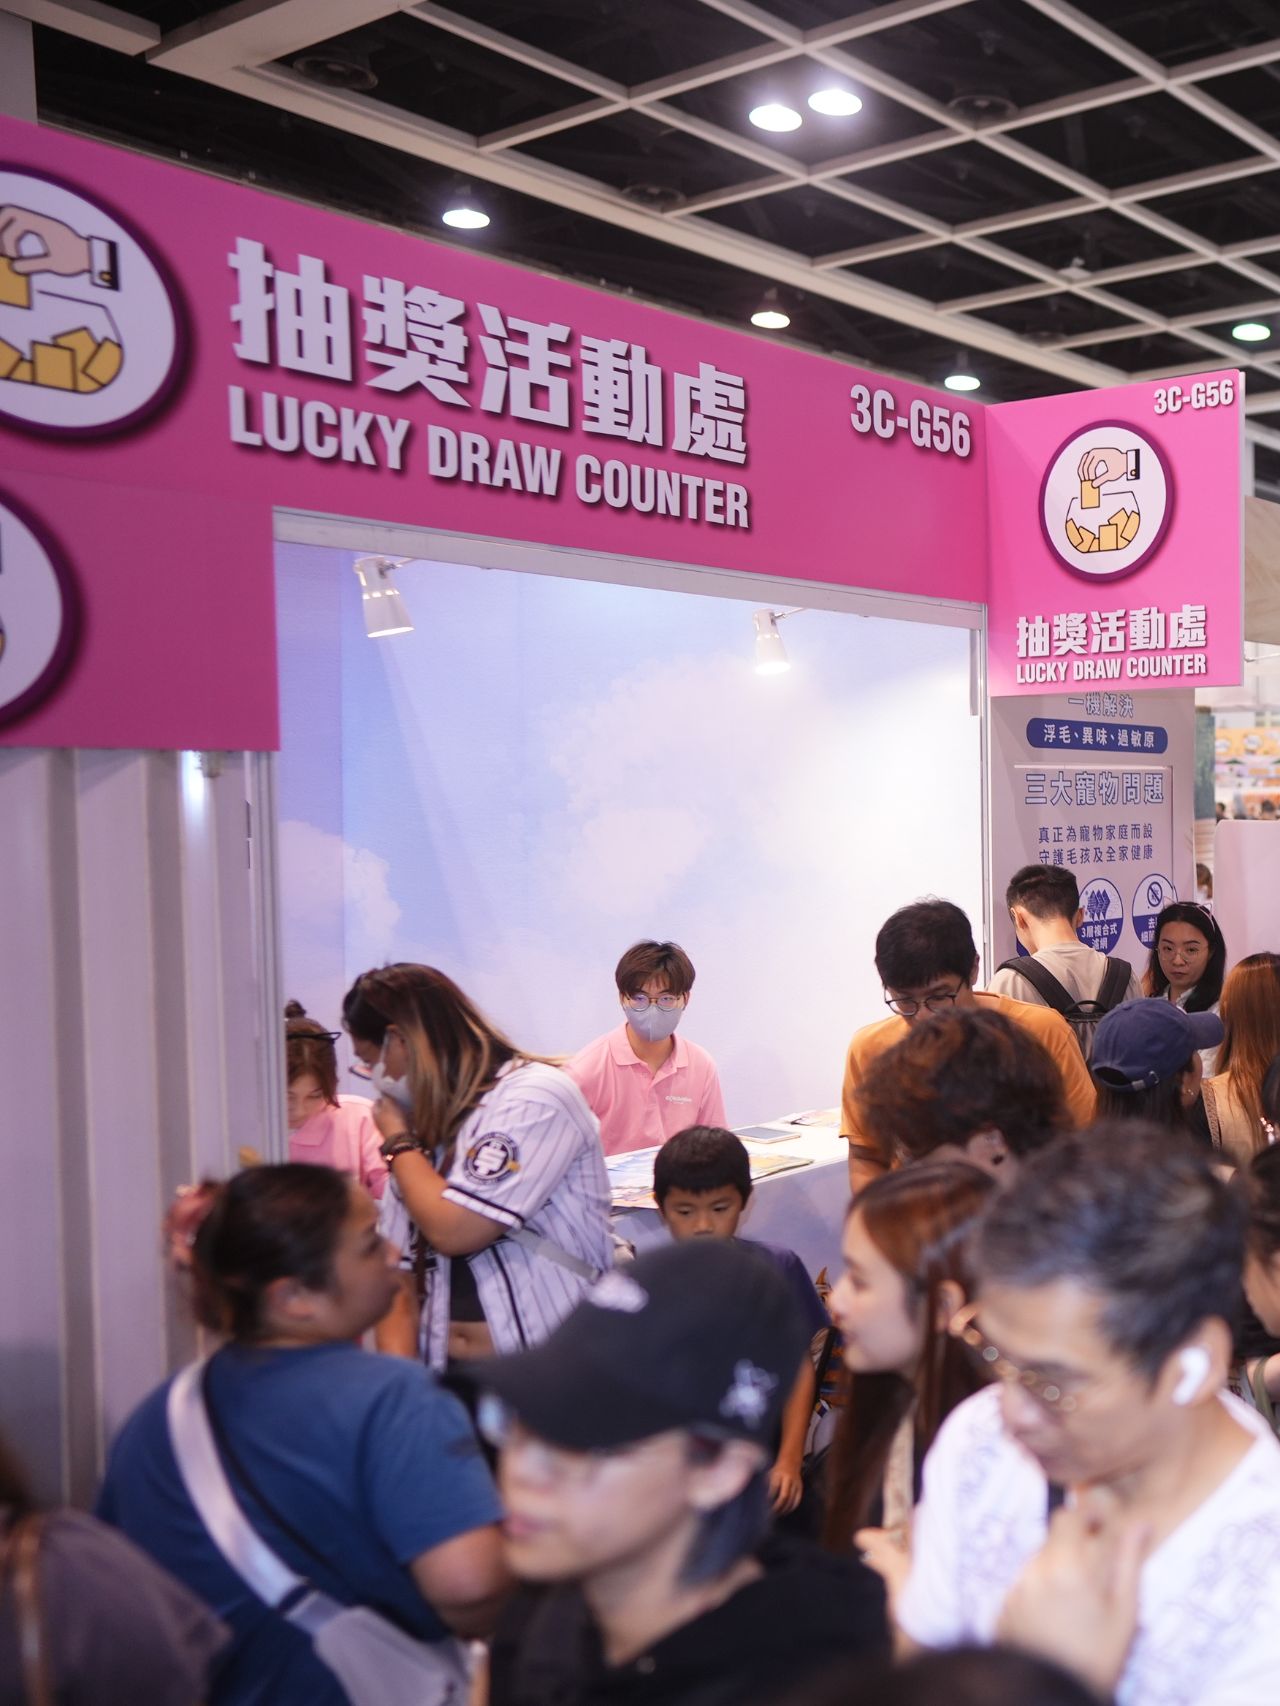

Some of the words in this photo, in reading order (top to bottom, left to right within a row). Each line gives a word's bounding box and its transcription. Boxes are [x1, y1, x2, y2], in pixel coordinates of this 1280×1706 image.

[227, 236, 748, 466] 抽獎活動處
[1154, 379, 1234, 415] 3C-G56
[849, 383, 972, 457] 3C-G56
[229, 386, 410, 471] LUCKY
[428, 424, 561, 498] DRAW
[576, 452, 749, 529] COUNTER
[1016, 604, 1207, 659] 抽獎活動處
[1016, 662, 1067, 684] LUCKY
[1073, 658, 1121, 680] DRAW
[1126, 653, 1207, 677] COUNTER
[1068, 692, 1134, 718] 一機解決
[1043, 723, 1156, 748] 浮毛、異味、過敏原
[1025, 770, 1164, 806] 三大寵物問題
[1038, 823, 1153, 844] 真正為寵物家庭而設
[1039, 844, 1153, 866] 守護毛孩及全家健康
